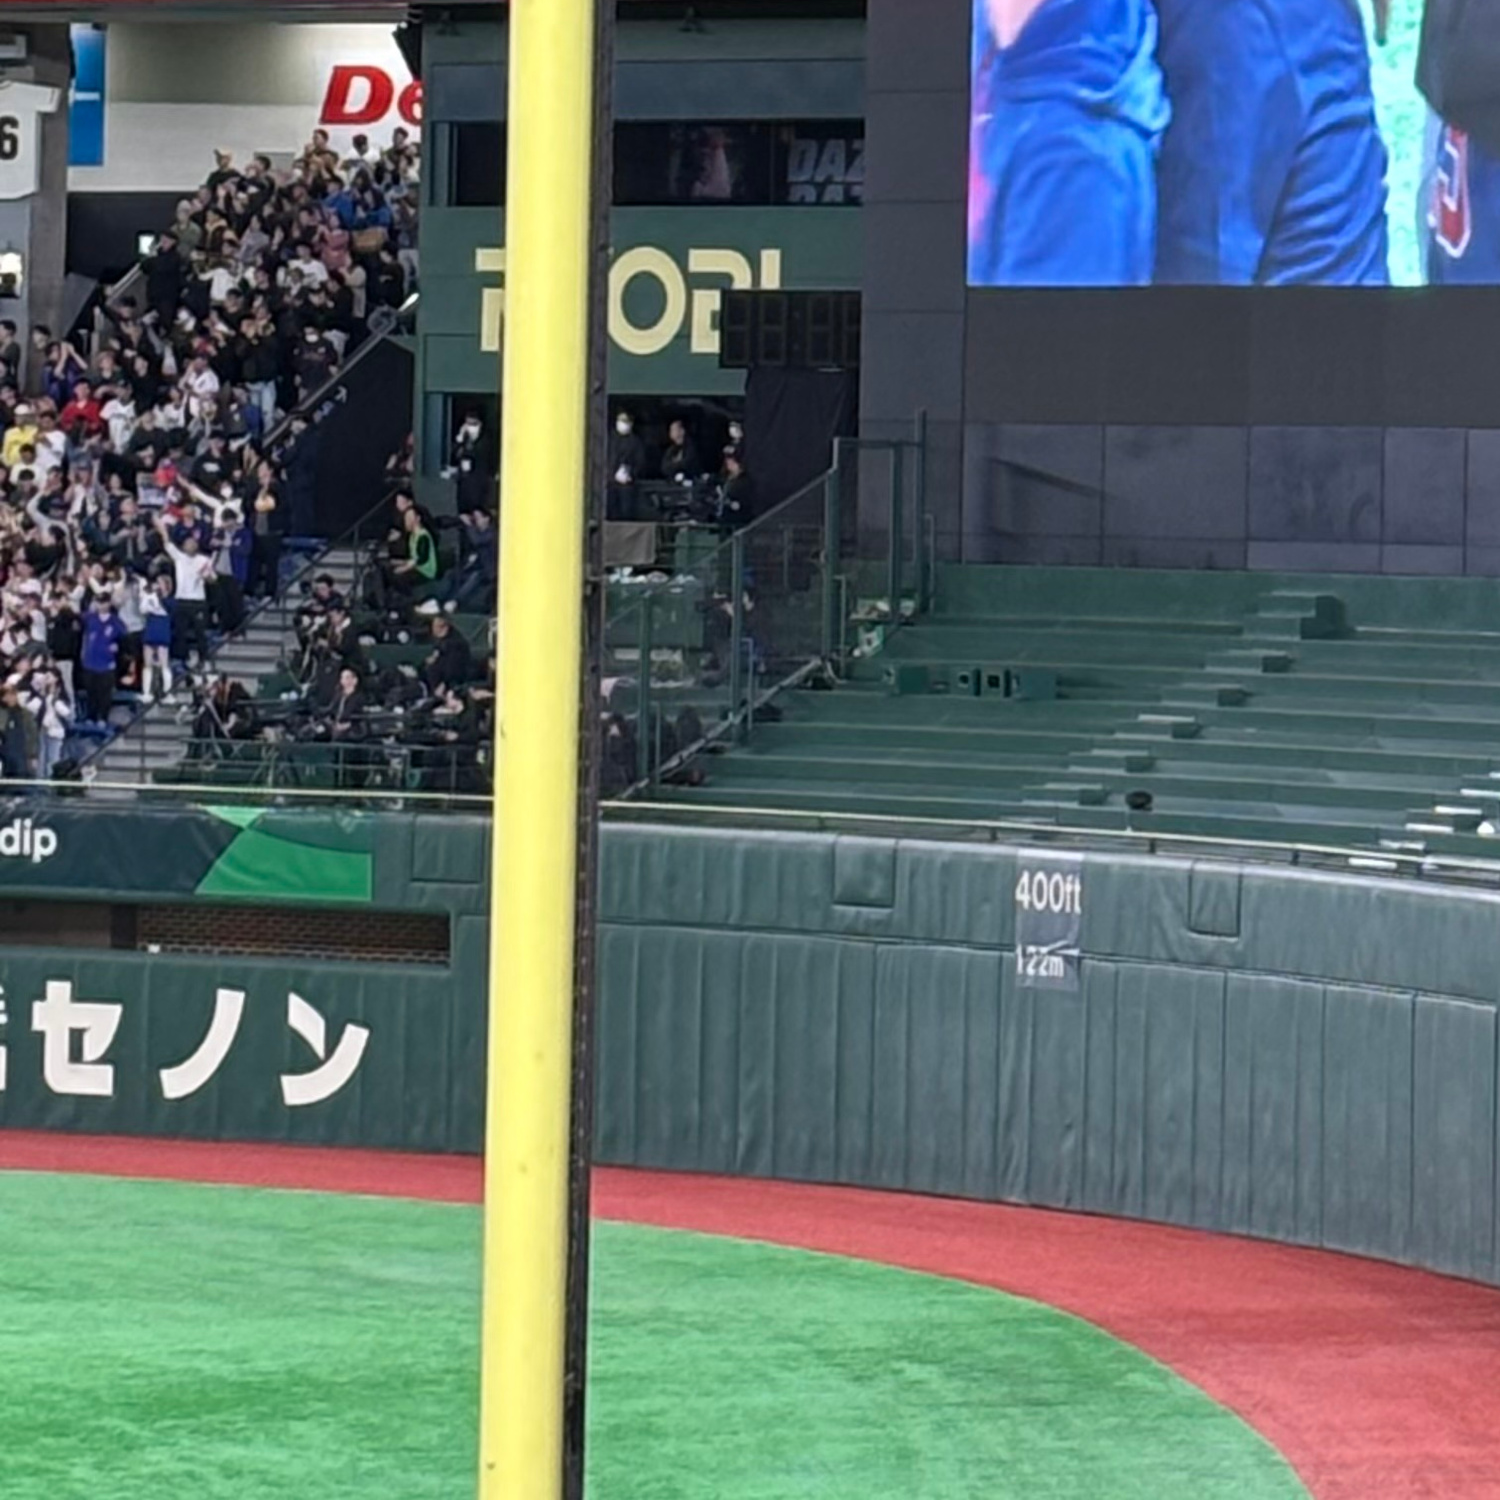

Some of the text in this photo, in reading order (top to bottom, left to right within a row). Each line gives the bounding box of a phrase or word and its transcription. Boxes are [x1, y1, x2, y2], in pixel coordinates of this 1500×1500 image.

[0, 818, 57, 863] dip
[1015, 870, 1081, 914] 400ft
[0, 980, 370, 1106] セノン
